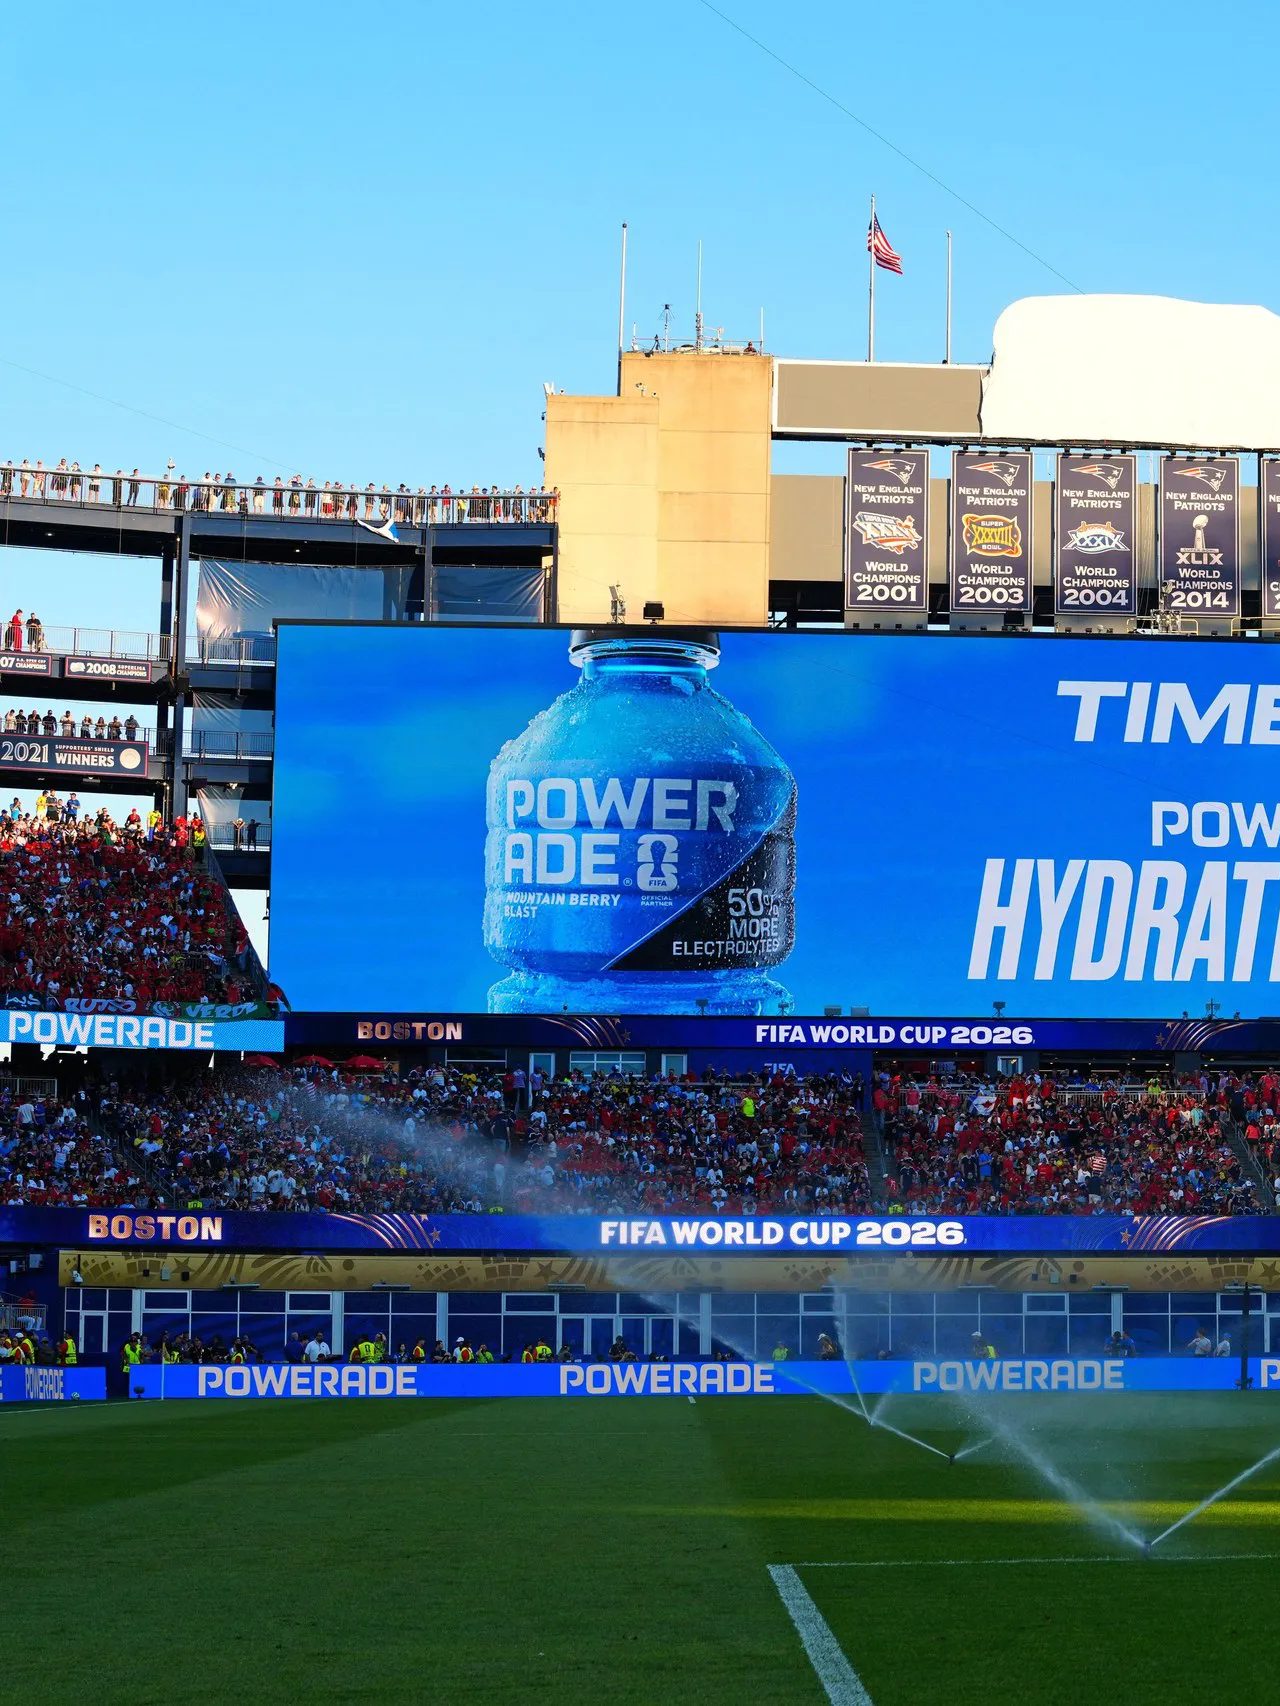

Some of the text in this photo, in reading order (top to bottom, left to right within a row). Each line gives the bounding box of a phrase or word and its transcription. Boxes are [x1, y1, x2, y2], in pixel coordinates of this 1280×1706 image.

[972, 524, 1013, 546] XXXVIII
[1176, 552, 1224, 565] XLIX
[857, 585, 917, 602] 2001
[959, 587, 1024, 604] 2003
[1064, 589, 1128, 606] 2004
[1170, 592, 1229, 608] 2014
[0, 656, 15, 668] 07
[16, 662, 46, 670] CHAMPIONS
[86, 662, 117, 675] 2008
[1, 741, 49, 763] 2021
[56, 753, 114, 767] WINNERS
[506, 778, 739, 832] POWER
[504, 833, 620, 886] ADE
[648, 879, 668, 888] FIFA
[506, 892, 621, 907] MOUNTAIN BERRY
[727, 888, 780, 917] 50%
[504, 906, 538, 918] BLAST
[729, 918, 779, 938] MORE
[672, 940, 781, 956] ELECTROLYTES
[8, 1012, 214, 1048] POWERADE
[357, 1022, 462, 1040] BOSTON
[756, 1024, 1034, 1044] FIFA WORLD CUP 2026
[88, 1214, 222, 1241] BOSTON
[601, 1220, 965, 1246] FIFA WORLD CUP 2026
[25, 1367, 64, 1400] POWERADE
[198, 1365, 418, 1398] POWERADE
[560, 1362, 774, 1394] POWERADE
[912, 1360, 1124, 1391] POWERADE
